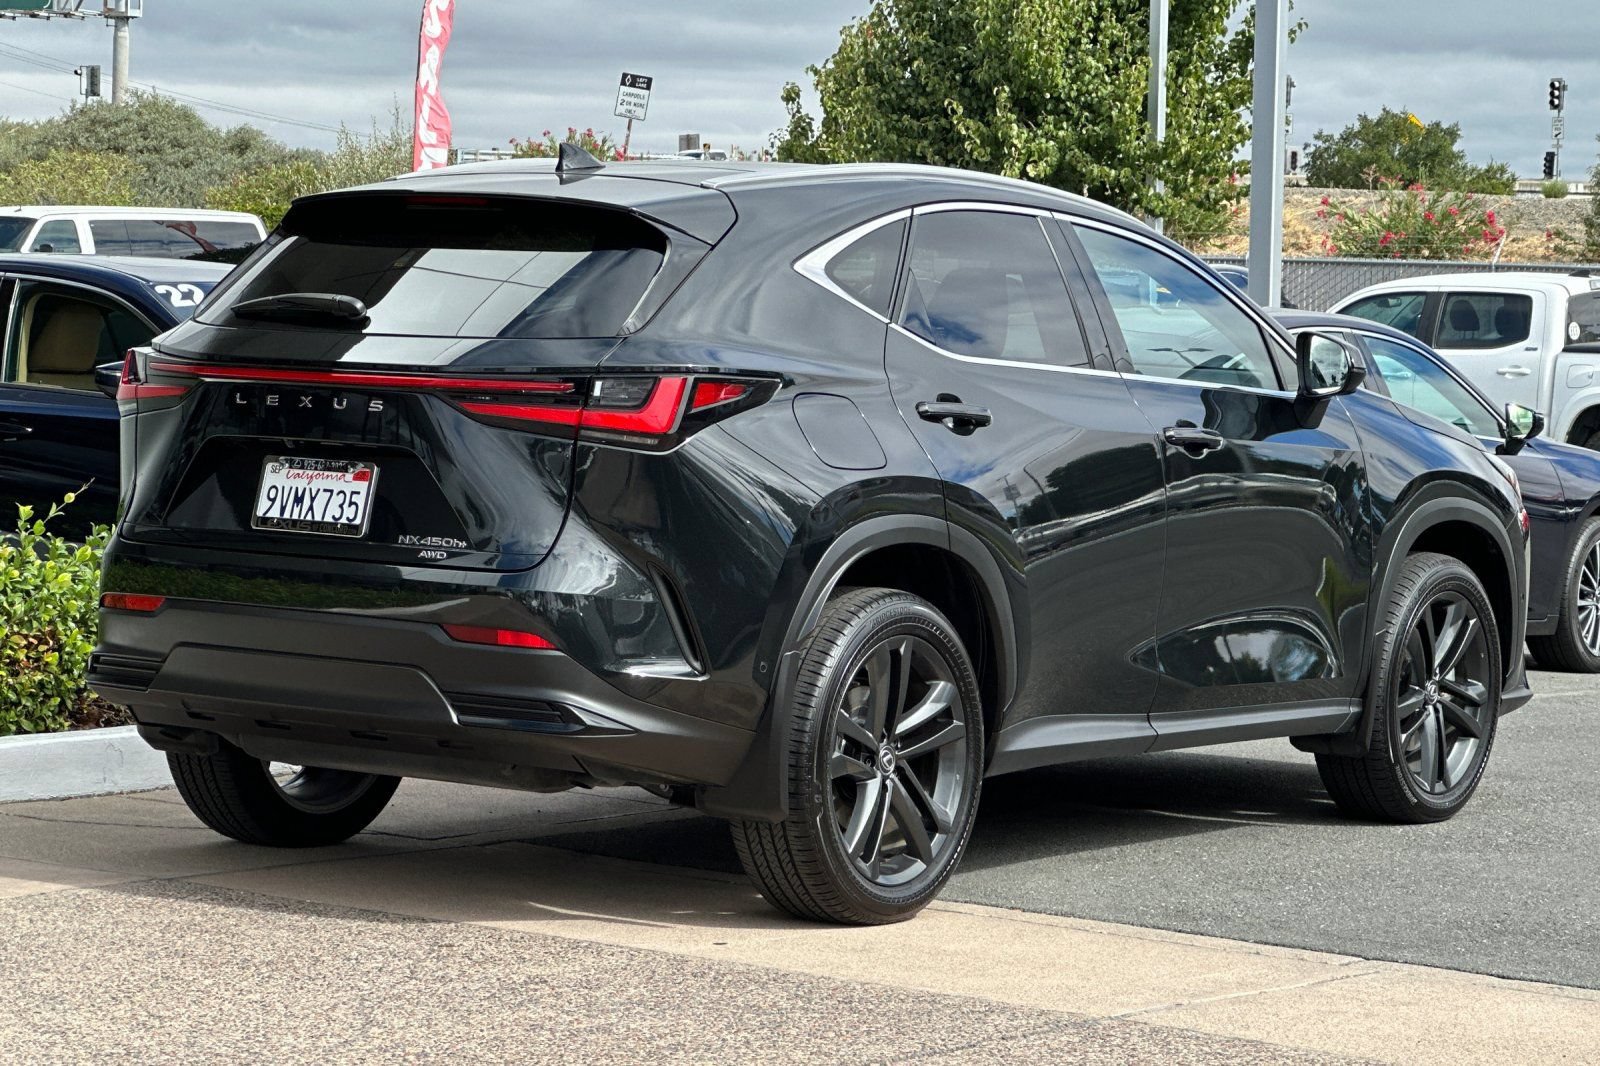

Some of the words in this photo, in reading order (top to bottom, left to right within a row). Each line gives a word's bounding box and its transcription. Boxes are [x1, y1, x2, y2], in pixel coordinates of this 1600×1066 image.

[620, 98, 626, 106] 2
[154, 283, 205, 307] 22
[235, 392, 384, 412] LEXUS
[286, 469, 347, 486] California
[262, 484, 361, 524] 9VMX735
[417, 550, 447, 559] AWD
